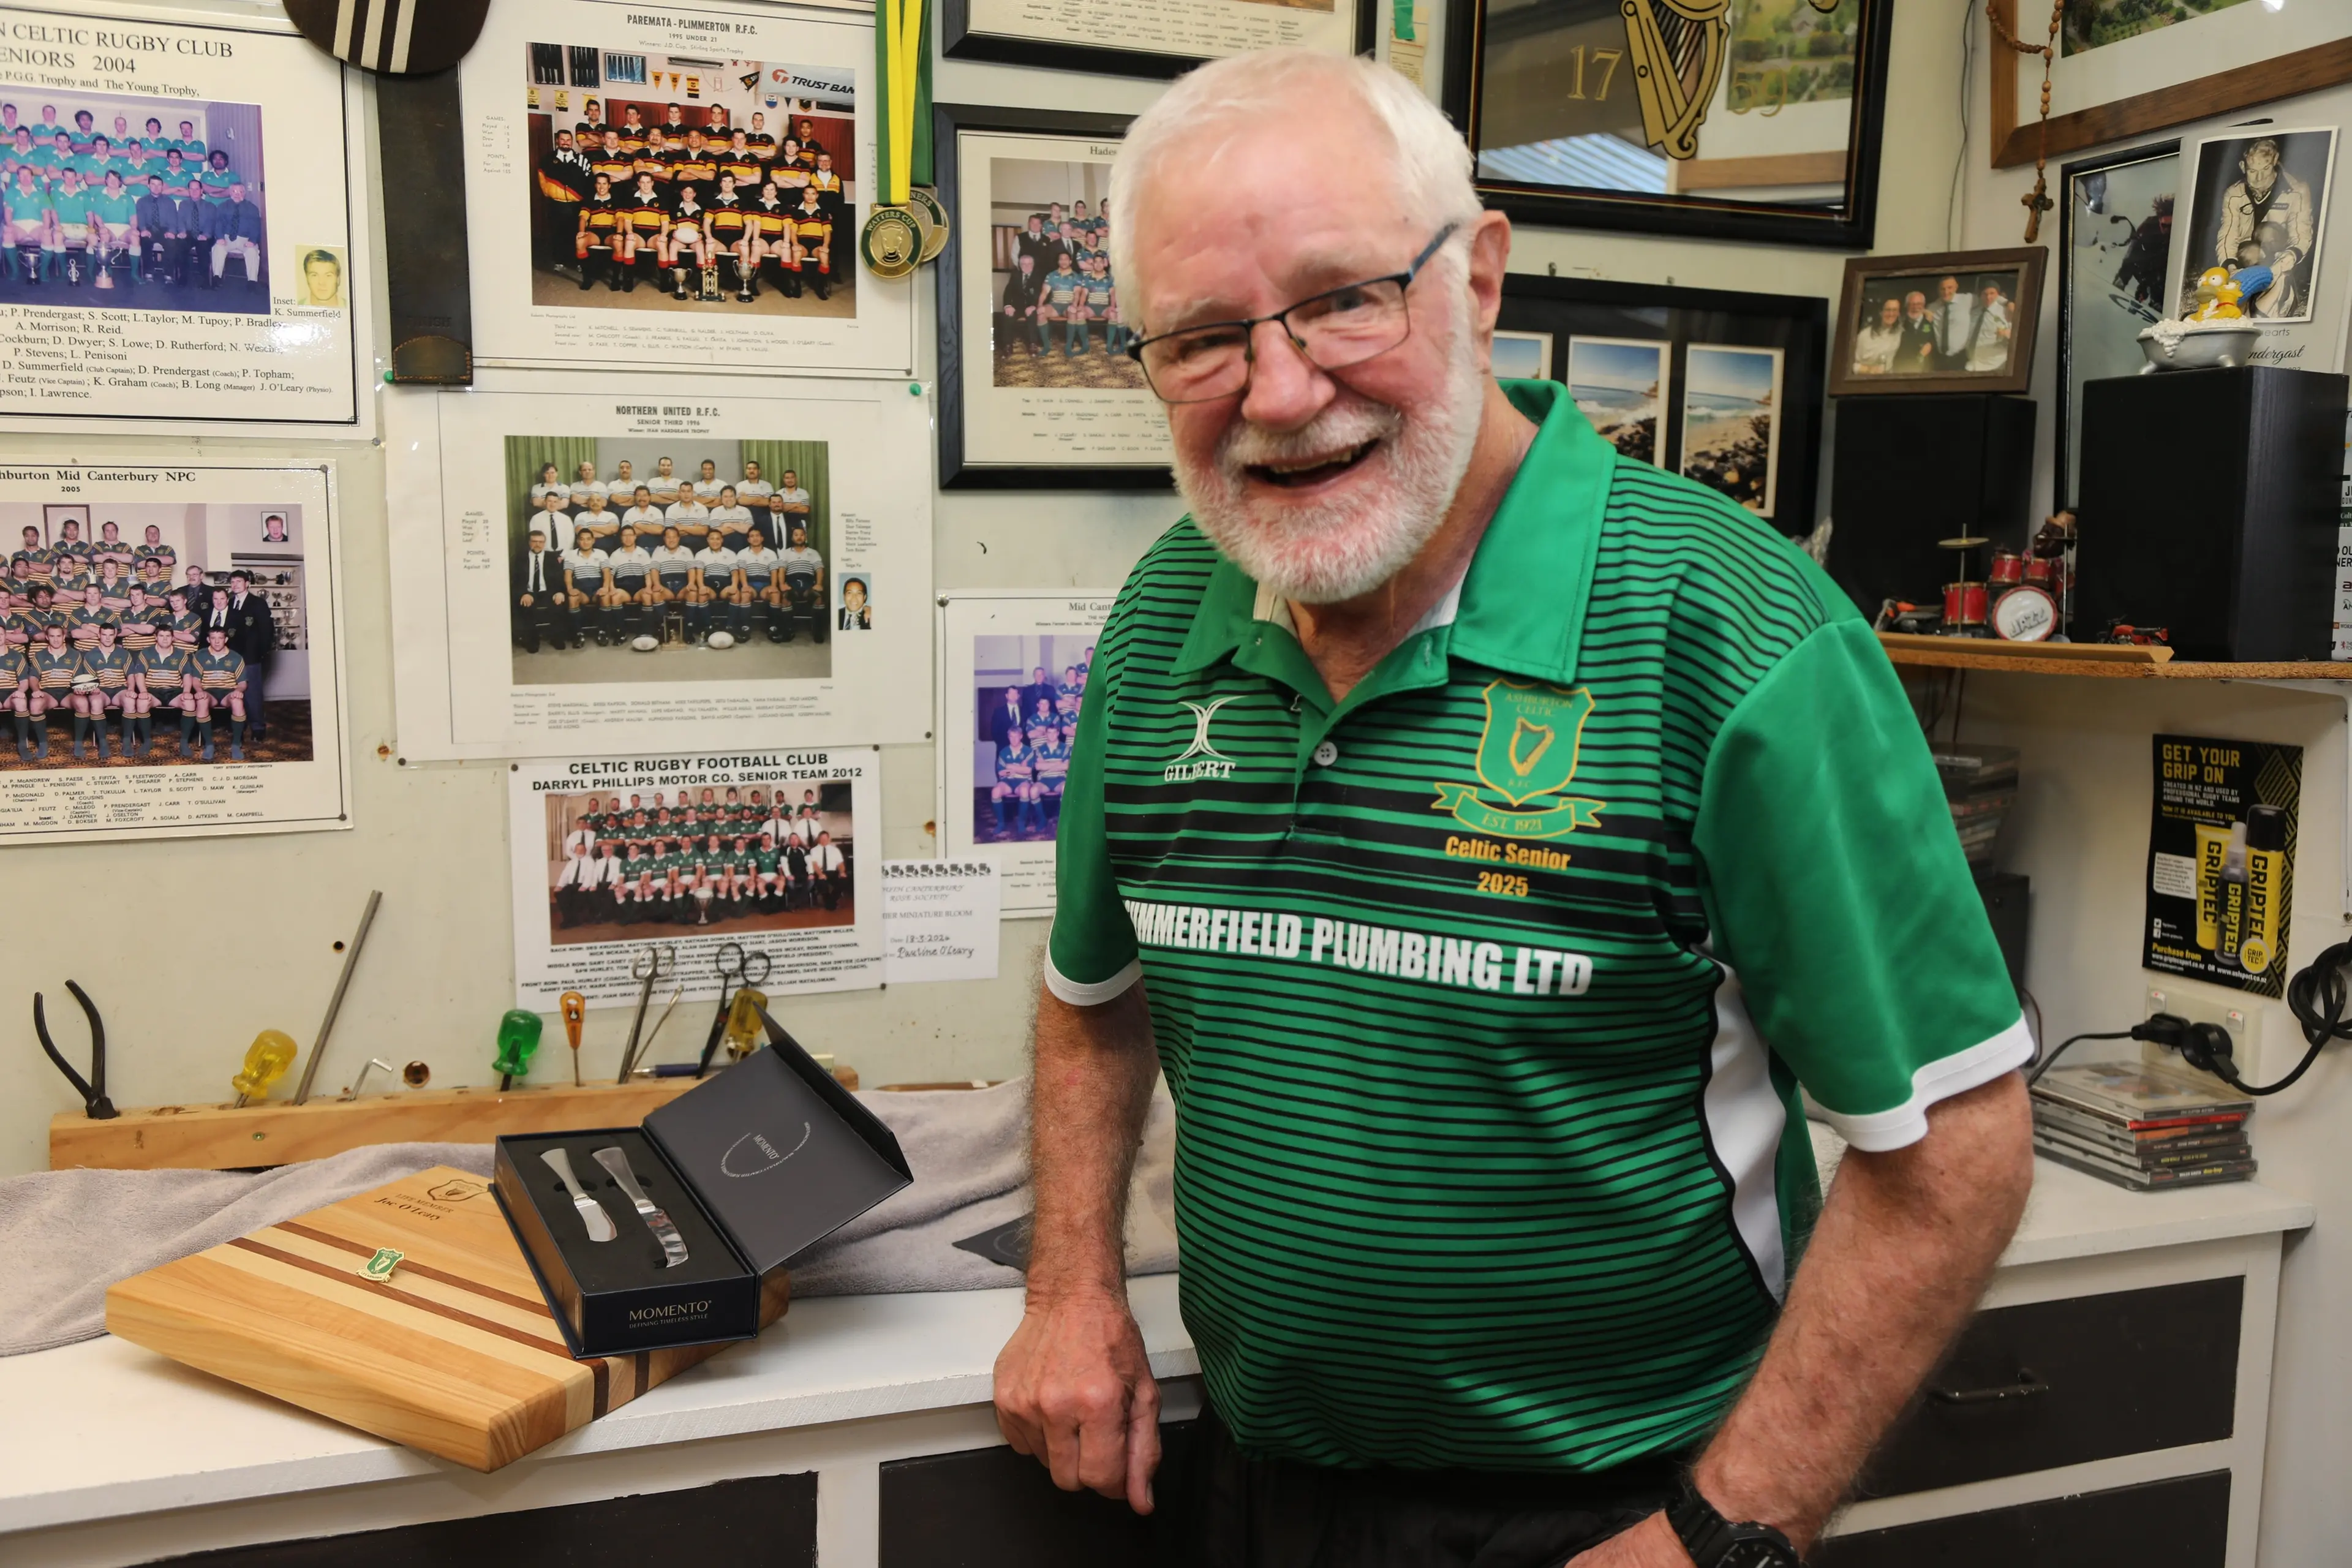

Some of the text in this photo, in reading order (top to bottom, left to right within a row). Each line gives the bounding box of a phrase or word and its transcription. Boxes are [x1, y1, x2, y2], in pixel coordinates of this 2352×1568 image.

[627, 14, 672, 28] PAREMATA
[679, 19, 730, 32] PLIMMERTON
[736, 24, 758, 35] R.F.C.
[13, 23, 233, 58] CELTIC RUGBY CLUB
[92, 56, 136, 73] 2004
[1567, 44, 1623, 101] 17
[6, 71, 200, 97] P.G.G. Trophy and The Young Trophy,
[792, 76, 831, 89] TRUST
[866, 211, 916, 231] WATTERS CUP
[11, 308, 20, 317] P.
[23, 309, 85, 320] Prendergast;
[88, 311, 97, 320] S.
[102, 312, 130, 322] Scott;
[182, 315, 195, 324] M.
[198, 316, 233, 326] Tupoy;
[287, 309, 341, 318] Summerfield
[31, 322, 80, 333] Morrison;
[98, 325, 123, 334] Reid.
[14, 348, 23, 356] P.
[26, 349, 67, 358] Stevens;
[85, 350, 127, 360] Penisoni
[2, 361, 14, 369] D.
[18, 361, 83, 372] Summerfield
[138, 366, 149, 374] D.
[153, 366, 209, 377] Prendergast
[254, 370, 294, 380] Topham;
[616, 405, 720, 417] NORTHERN UNITED R.F.C.
[56, 470, 80, 480] Mid
[88, 470, 159, 483] Canterbury
[165, 472, 195, 481] NPC
[1069, 602, 1086, 611] Mid
[1506, 693, 1574, 717] ASHBURTON CELTIC
[569, 753, 828, 774] CELTIC RUGBY FOOTBALL CLUB
[2163, 744, 2239, 767] GET YOUR
[532, 767, 862, 791] DARRYL PHILLIPS MOTOR CO. SENIOR TEAM 2012
[2163, 762, 2223, 784] GRIP ON
[2163, 788, 2200, 798] PROFESSIONAL
[2187, 809, 2214, 818] AVAILABLE
[1515, 818, 1542, 832] 1921
[1446, 836, 1571, 870] Celtic Senior
[1477, 871, 1528, 897] 2025
[2204, 841, 2222, 924] GRIPTEC
[2225, 883, 2241, 953] GRIPTEC
[897, 946, 974, 959] Pauline O'Leary
[1311, 918, 1503, 990] PLUMBING
[1514, 944, 1594, 995] LTD
[2153, 943, 2201, 962] Purchase from
[2247, 948, 2263, 957] GRIP
[2247, 956, 2259, 965] TEC
[753, 1134, 778, 1159] MOMENTO
[374, 1197, 440, 1220] Joe O'Leary
[629, 1320, 659, 1329] DEFINING
